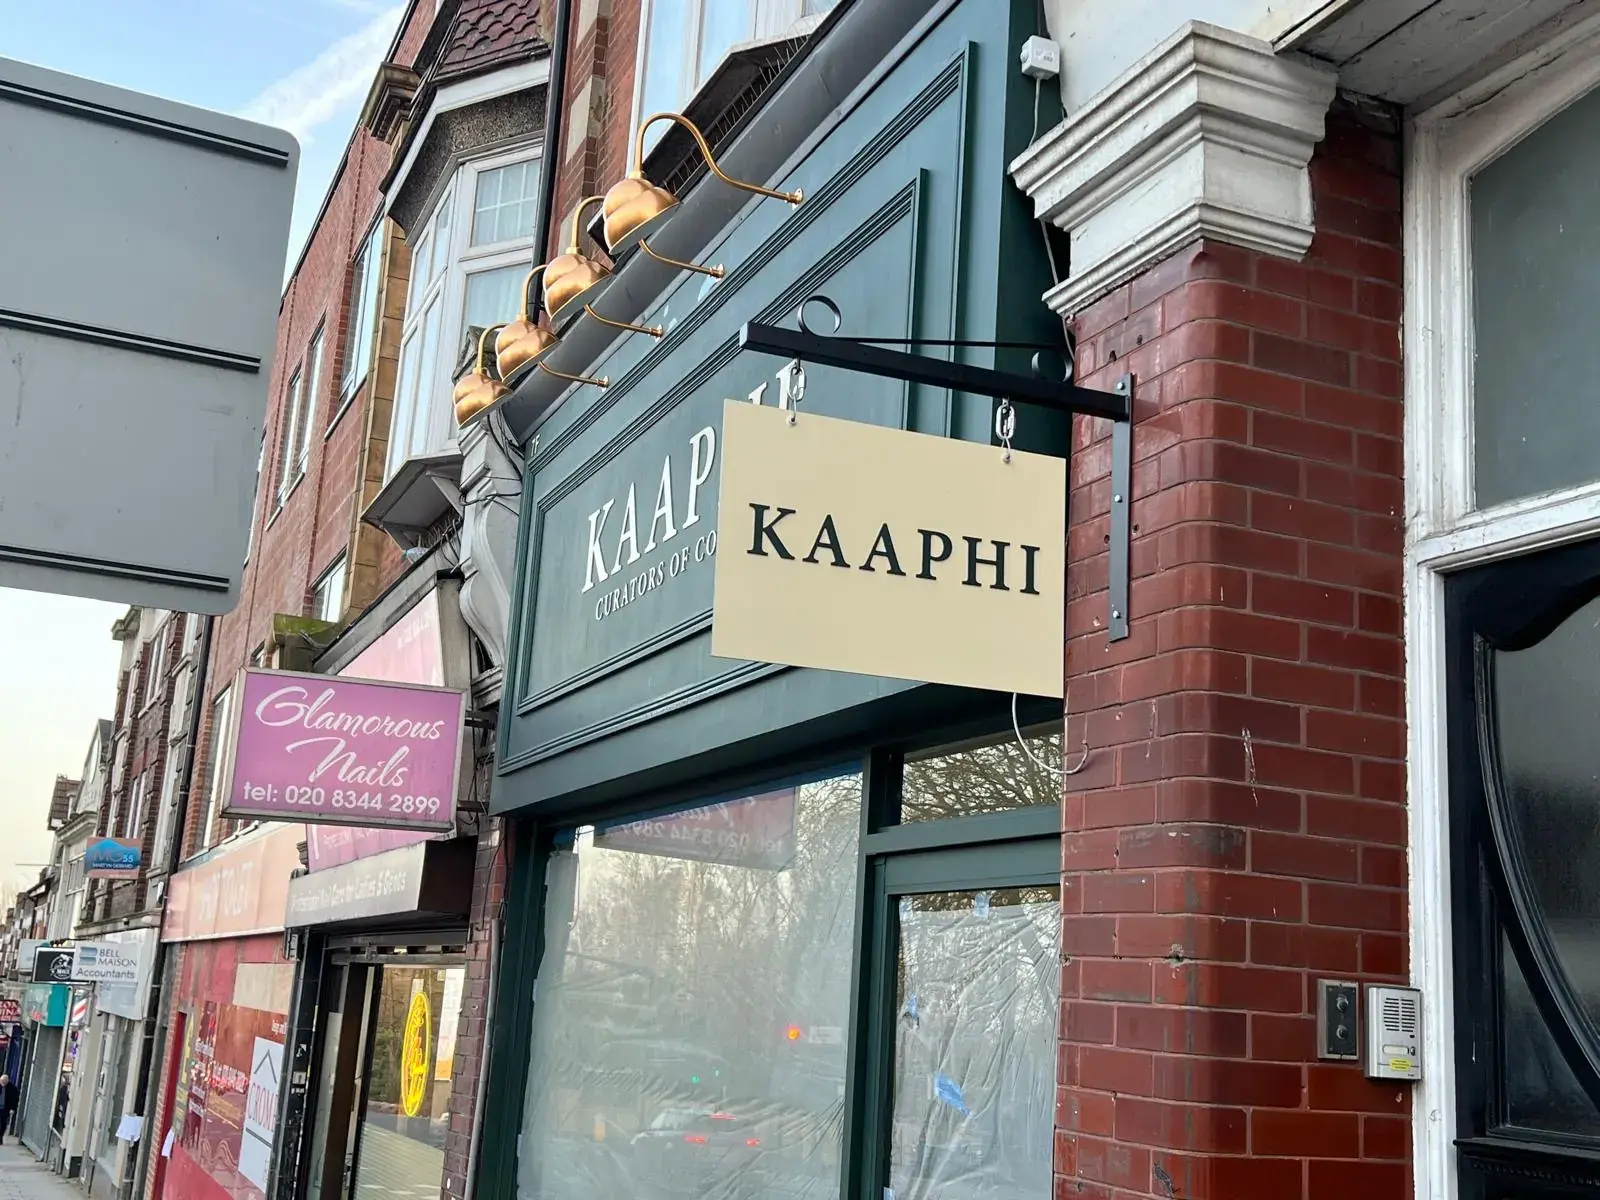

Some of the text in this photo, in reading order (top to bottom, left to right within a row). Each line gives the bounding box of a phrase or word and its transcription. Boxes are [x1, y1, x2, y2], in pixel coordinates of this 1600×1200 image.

[747, 502, 1040, 596] KAAPHI
[595, 560, 665, 621] CURATORS
[669, 546, 690, 578] OF
[255, 685, 446, 740] Glamorous
[285, 736, 410, 788] Nails
[243, 781, 441, 816] tel: 020 8344 2899
[76, 968, 136, 979] Accountants
[97, 958, 137, 967] MAISON
[100, 948, 120, 958] BELL
